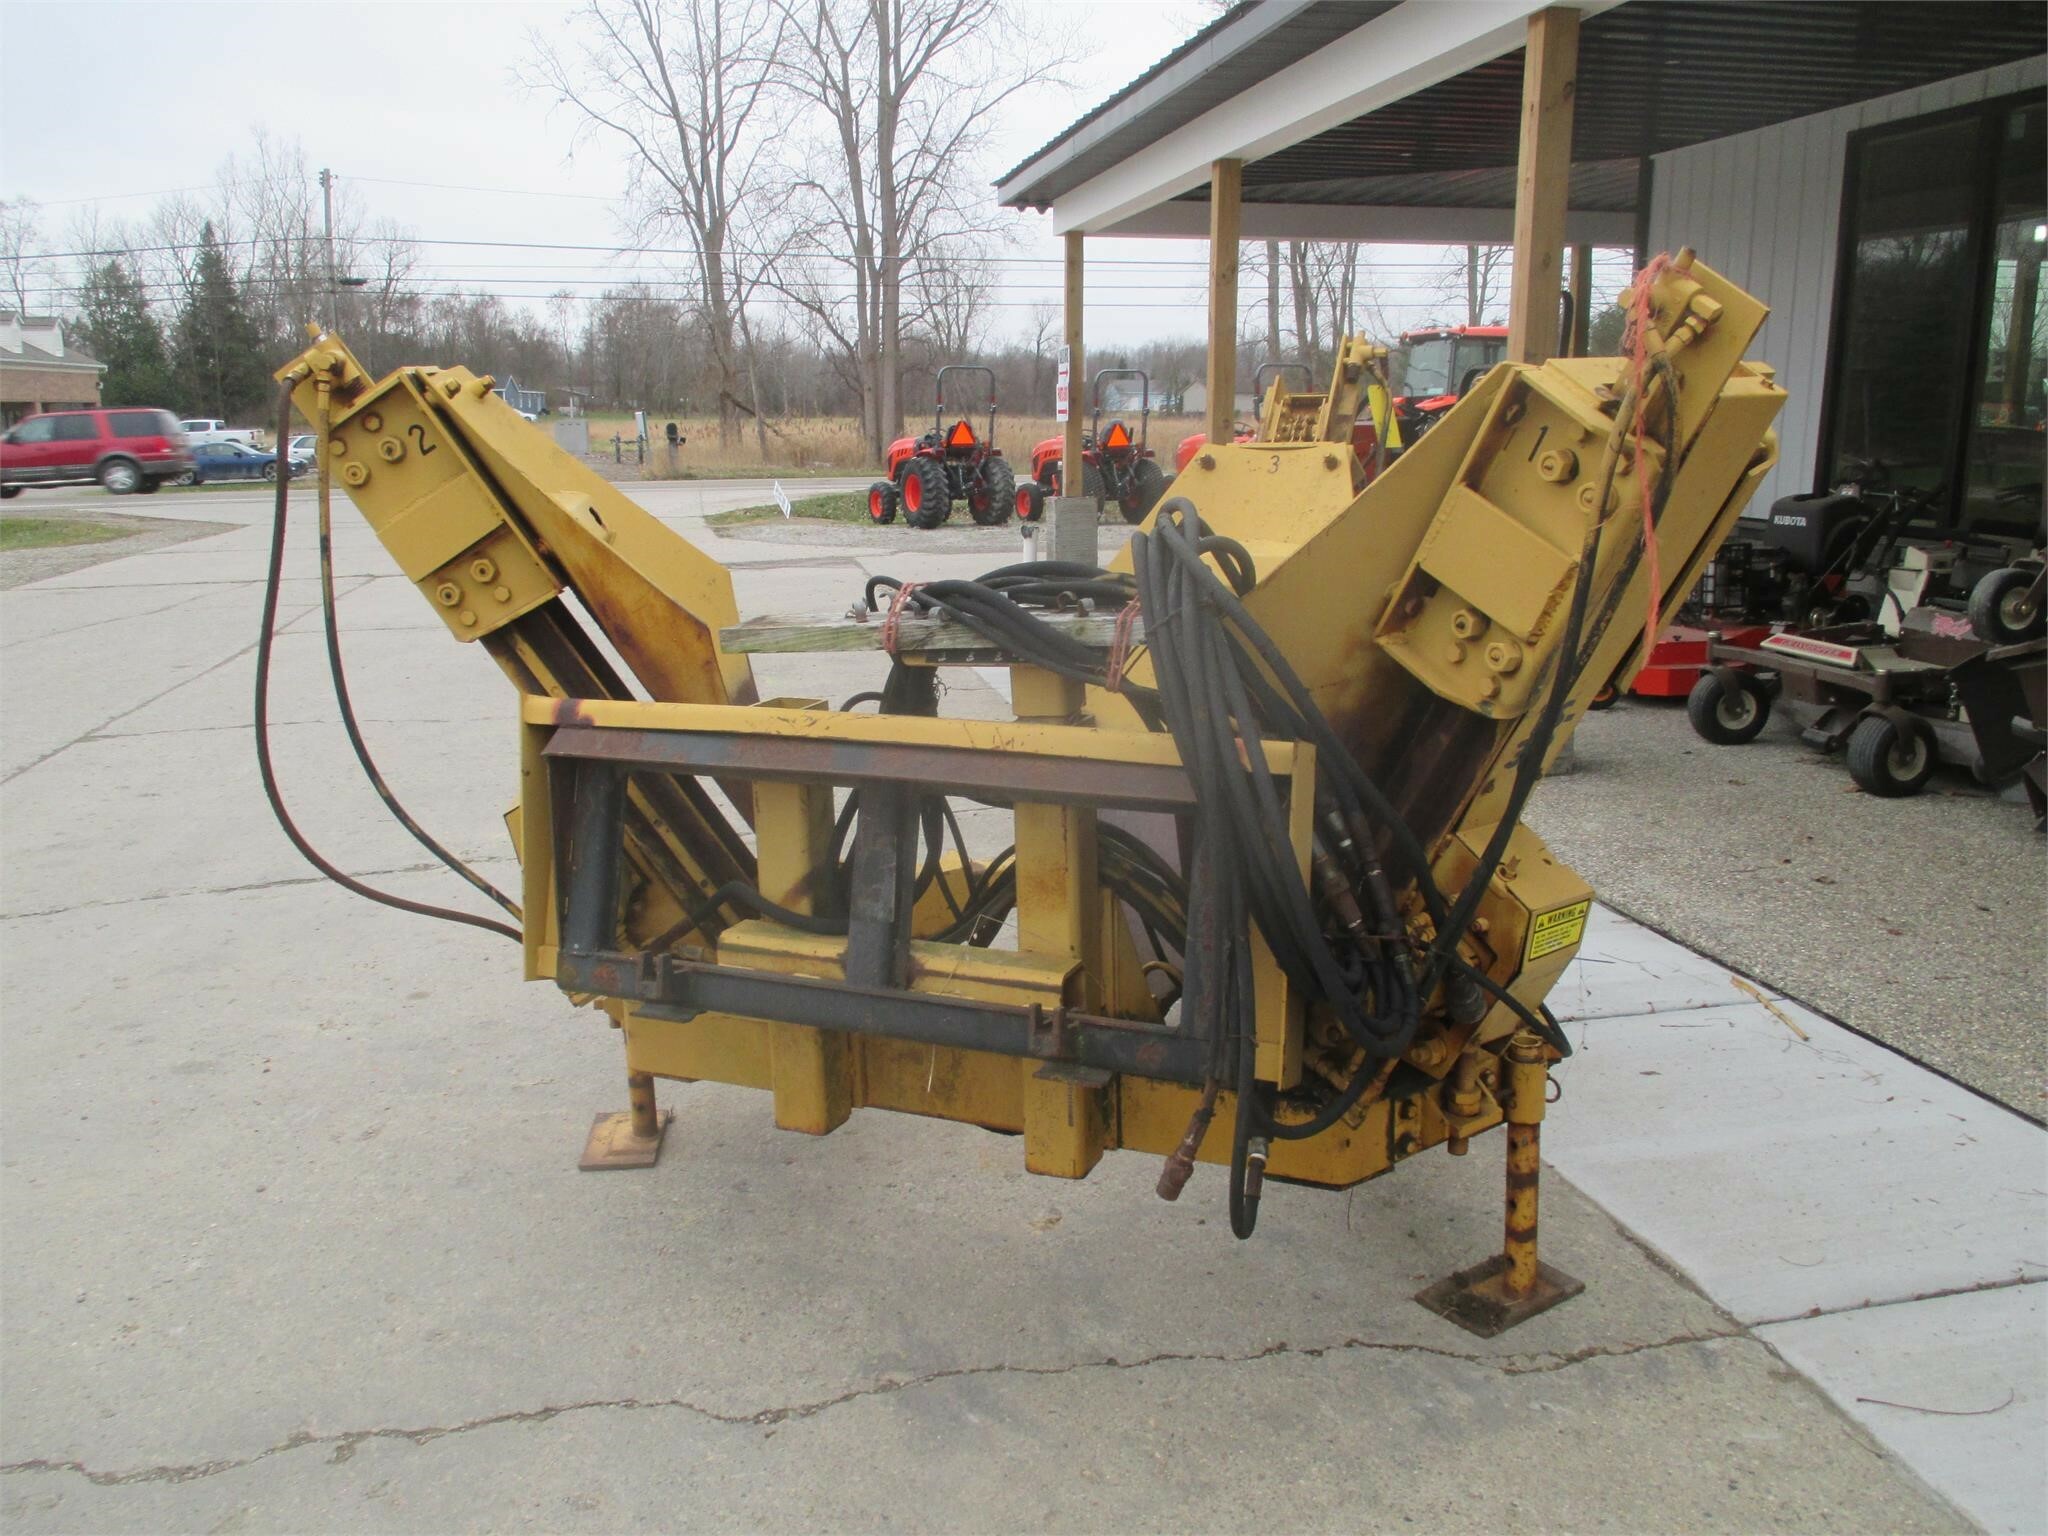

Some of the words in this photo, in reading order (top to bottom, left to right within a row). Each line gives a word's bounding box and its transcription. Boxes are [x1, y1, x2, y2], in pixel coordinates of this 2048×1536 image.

[408, 424, 437, 456] 2
[1528, 425, 1548, 462] 1
[1267, 455, 1280, 474] 3
[1773, 515, 1806, 527] KUBOTA
